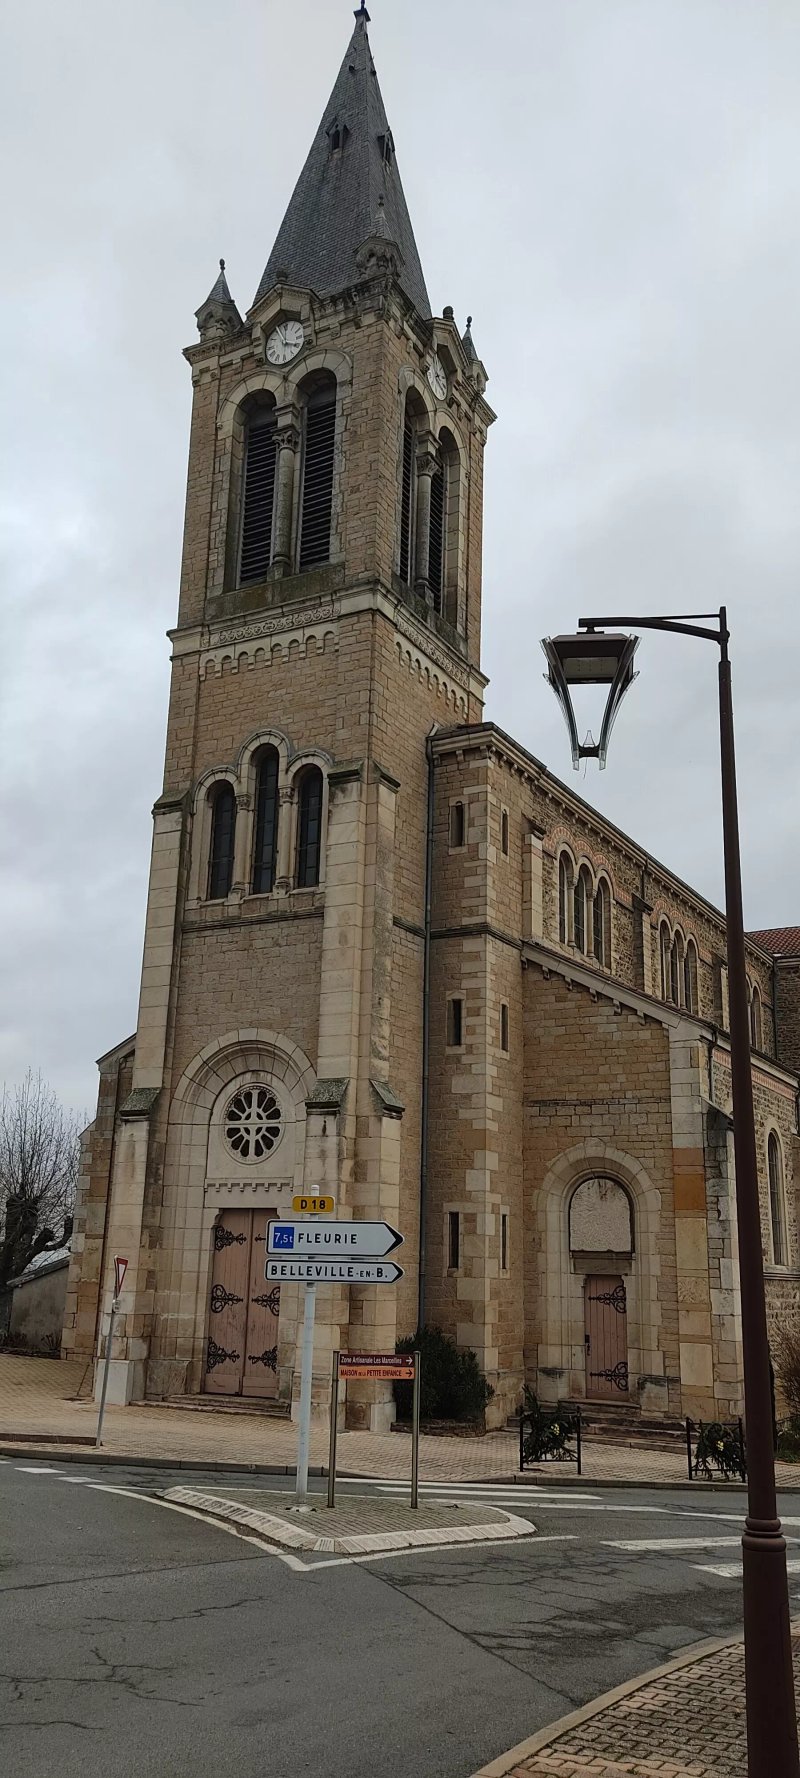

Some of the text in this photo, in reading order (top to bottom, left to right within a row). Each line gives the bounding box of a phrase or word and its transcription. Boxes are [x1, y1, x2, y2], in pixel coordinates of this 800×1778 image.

[300, 1200, 326, 1209] D 18
[298, 1233, 357, 1244] FLEURIE
[352, 1356, 373, 1364] Artisanale
